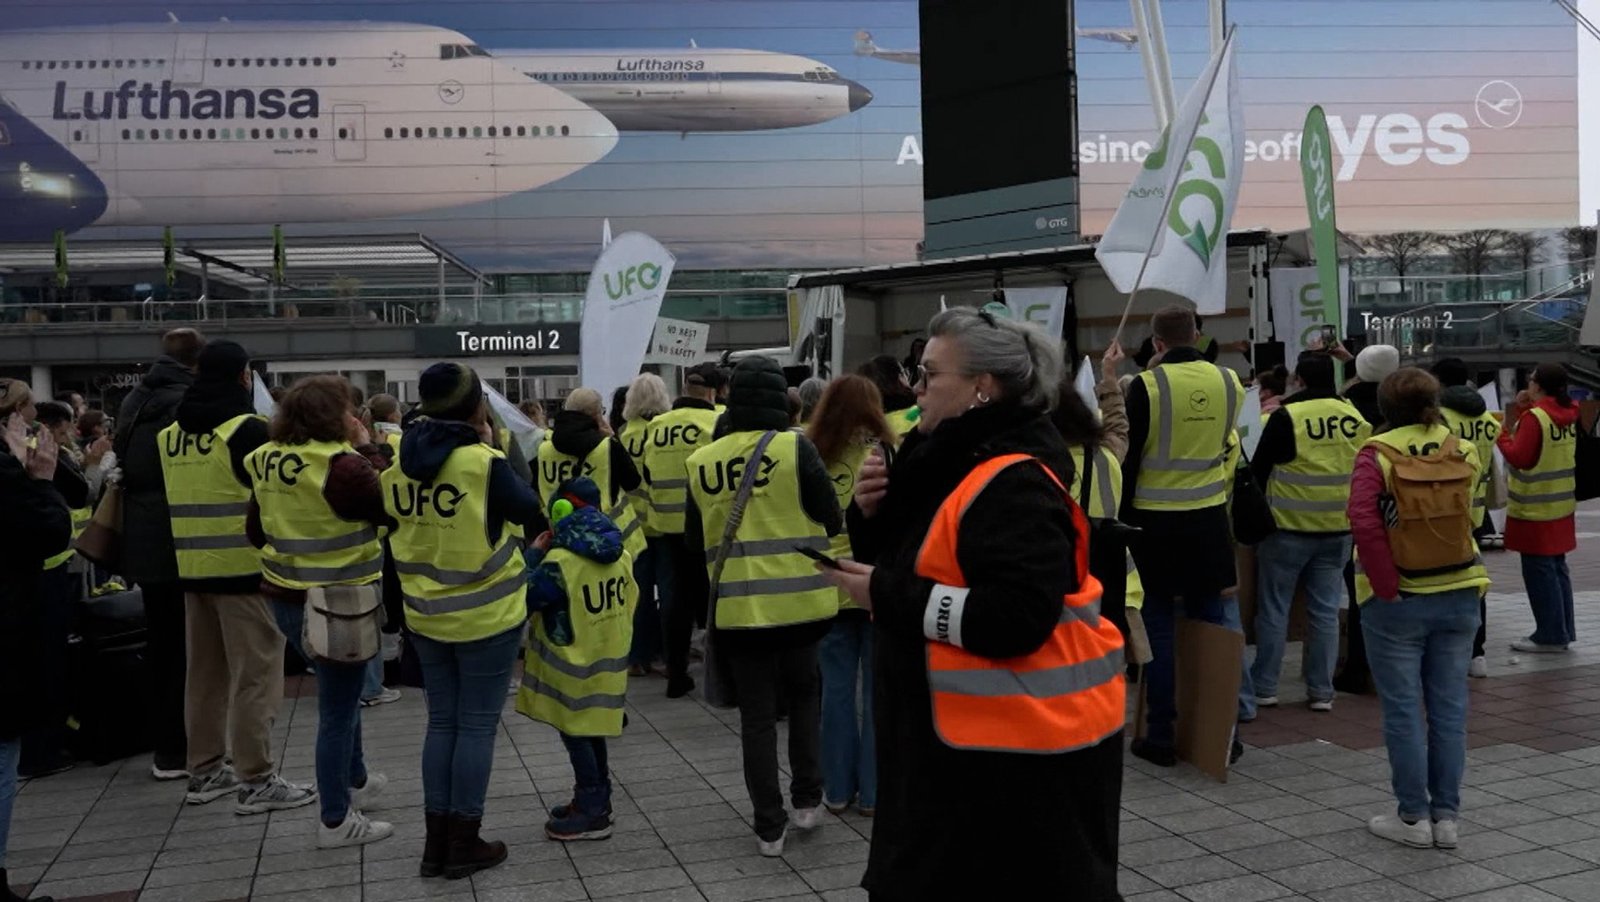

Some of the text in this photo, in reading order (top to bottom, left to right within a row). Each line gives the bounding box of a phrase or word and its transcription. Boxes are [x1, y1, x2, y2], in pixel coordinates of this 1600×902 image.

[617, 58, 705, 71] Lufthansa
[53, 80, 319, 120] Lufthansa
[1080, 135, 1150, 163] sinc
[1244, 133, 1302, 161] eoff
[1326, 112, 1470, 181] yes
[1048, 218, 1068, 229] GTG
[604, 262, 662, 300] UFO
[667, 325, 677, 334] NO
[1443, 310, 1453, 329] 2
[456, 330, 560, 351] Terminal 2
[670, 348, 696, 359] SAFETY
[654, 425, 702, 447] UFO
[1305, 415, 1361, 440] UFO
[1460, 420, 1496, 441] UFO
[166, 430, 216, 457] UFO
[252, 450, 310, 486] UFO
[699, 455, 780, 495] UFO
[392, 482, 469, 518] UFO
[582, 576, 629, 614] UFO
